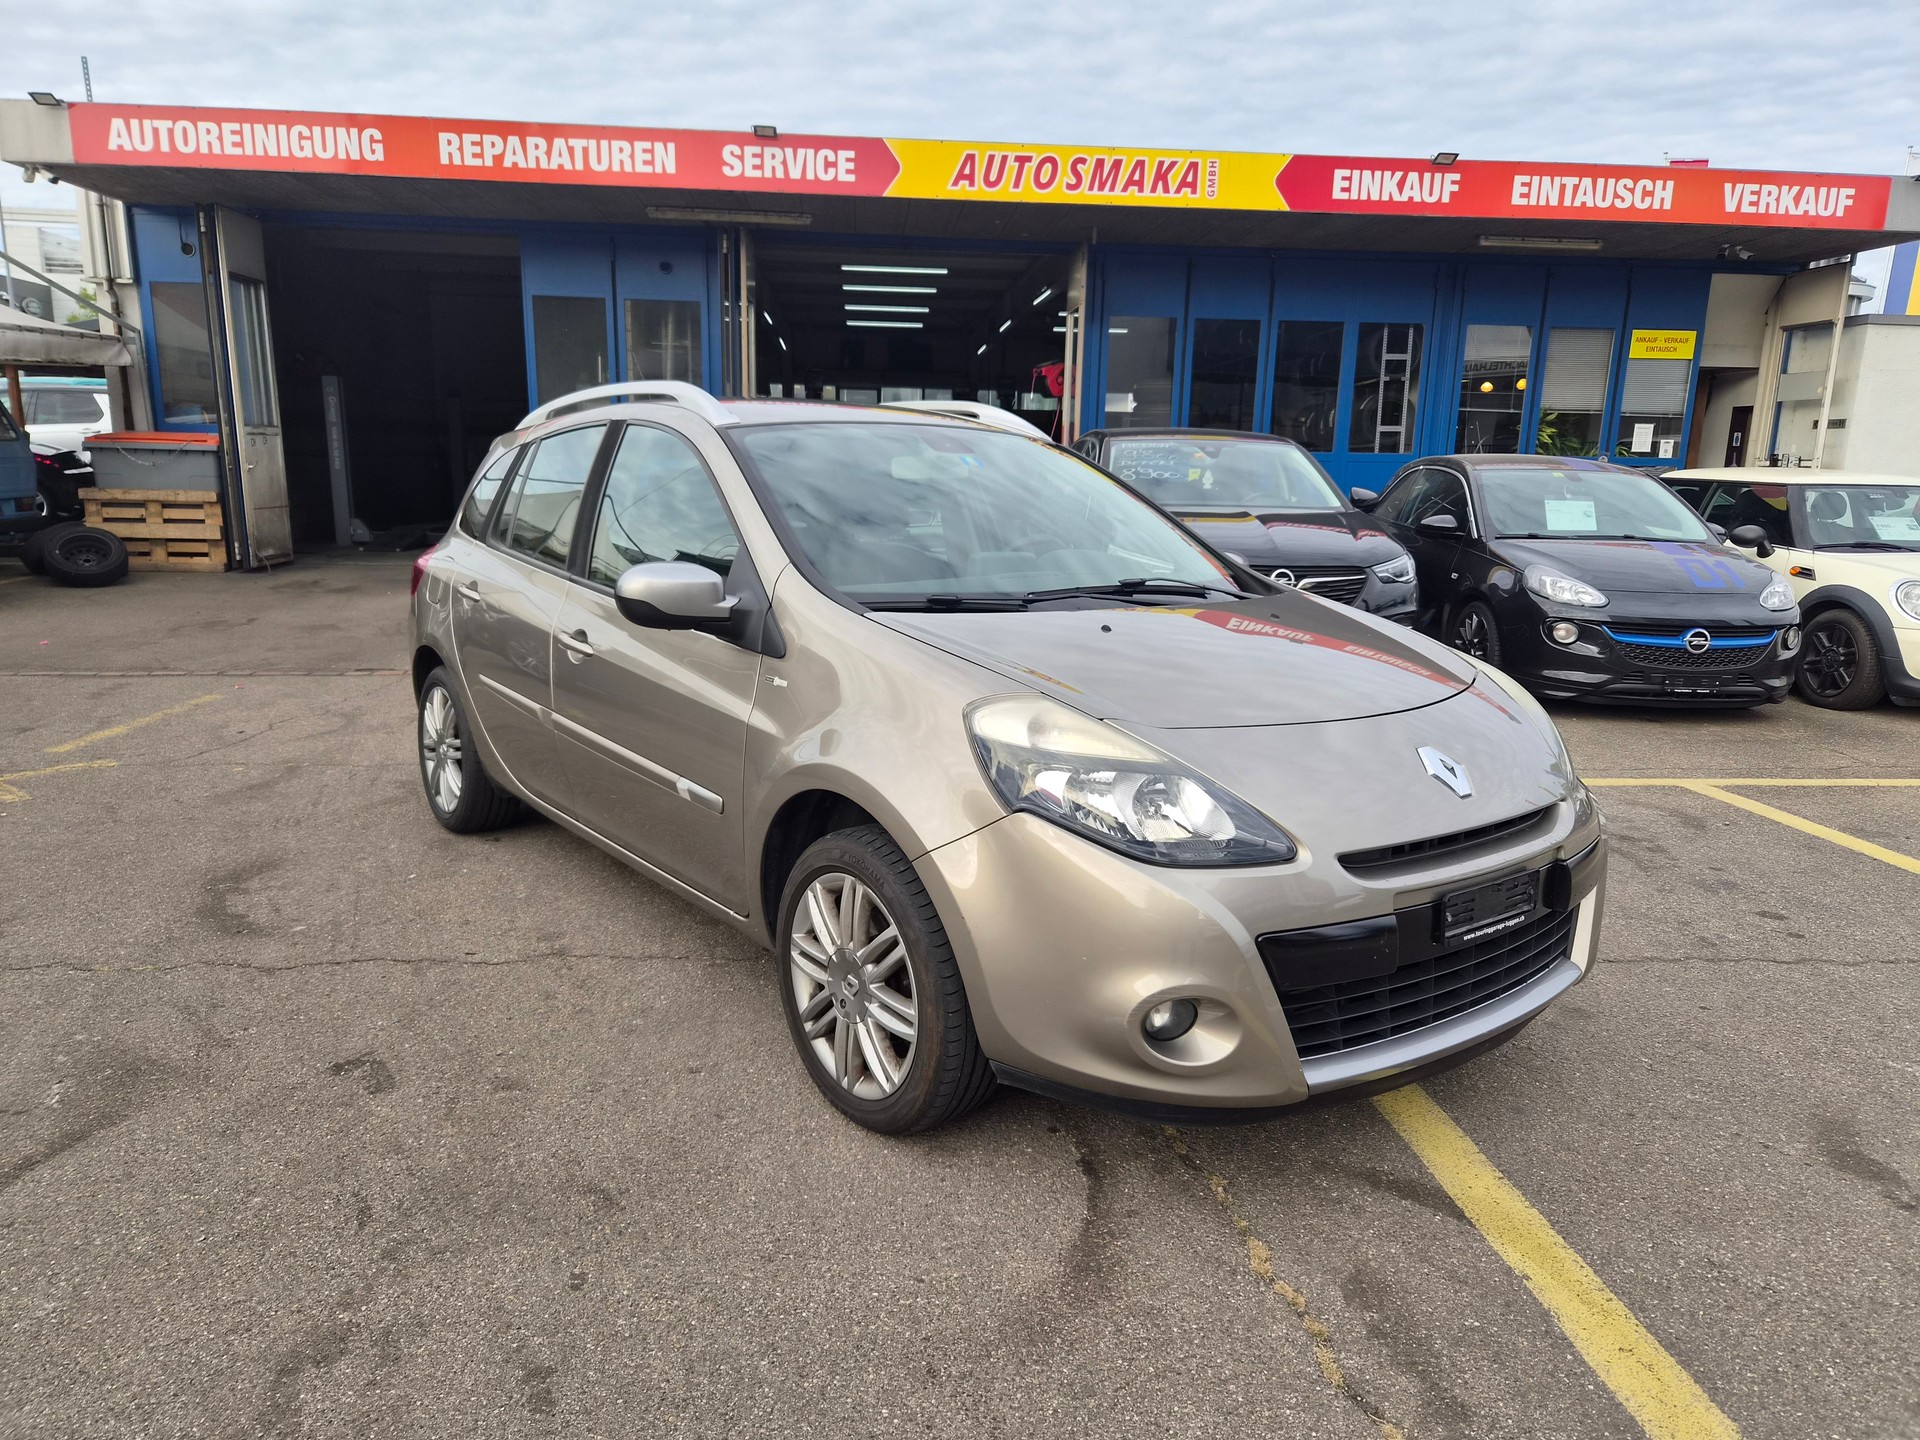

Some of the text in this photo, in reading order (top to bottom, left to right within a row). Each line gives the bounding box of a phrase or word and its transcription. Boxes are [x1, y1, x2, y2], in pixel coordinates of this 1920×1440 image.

[107, 117, 385, 162] AUTOREINIGUNG
[438, 132, 677, 175] REPARATUREN
[721, 143, 856, 183] SERVICE
[951, 153, 1199, 195] AUTO SMAKA
[1207, 160, 1217, 198] GMBH
[1331, 168, 1461, 204] EINKAUF
[1510, 174, 1675, 210] EINTAUSCH
[1724, 182, 1856, 217] VERKAUF
[848, 853, 885, 890] YOKOHAMA
